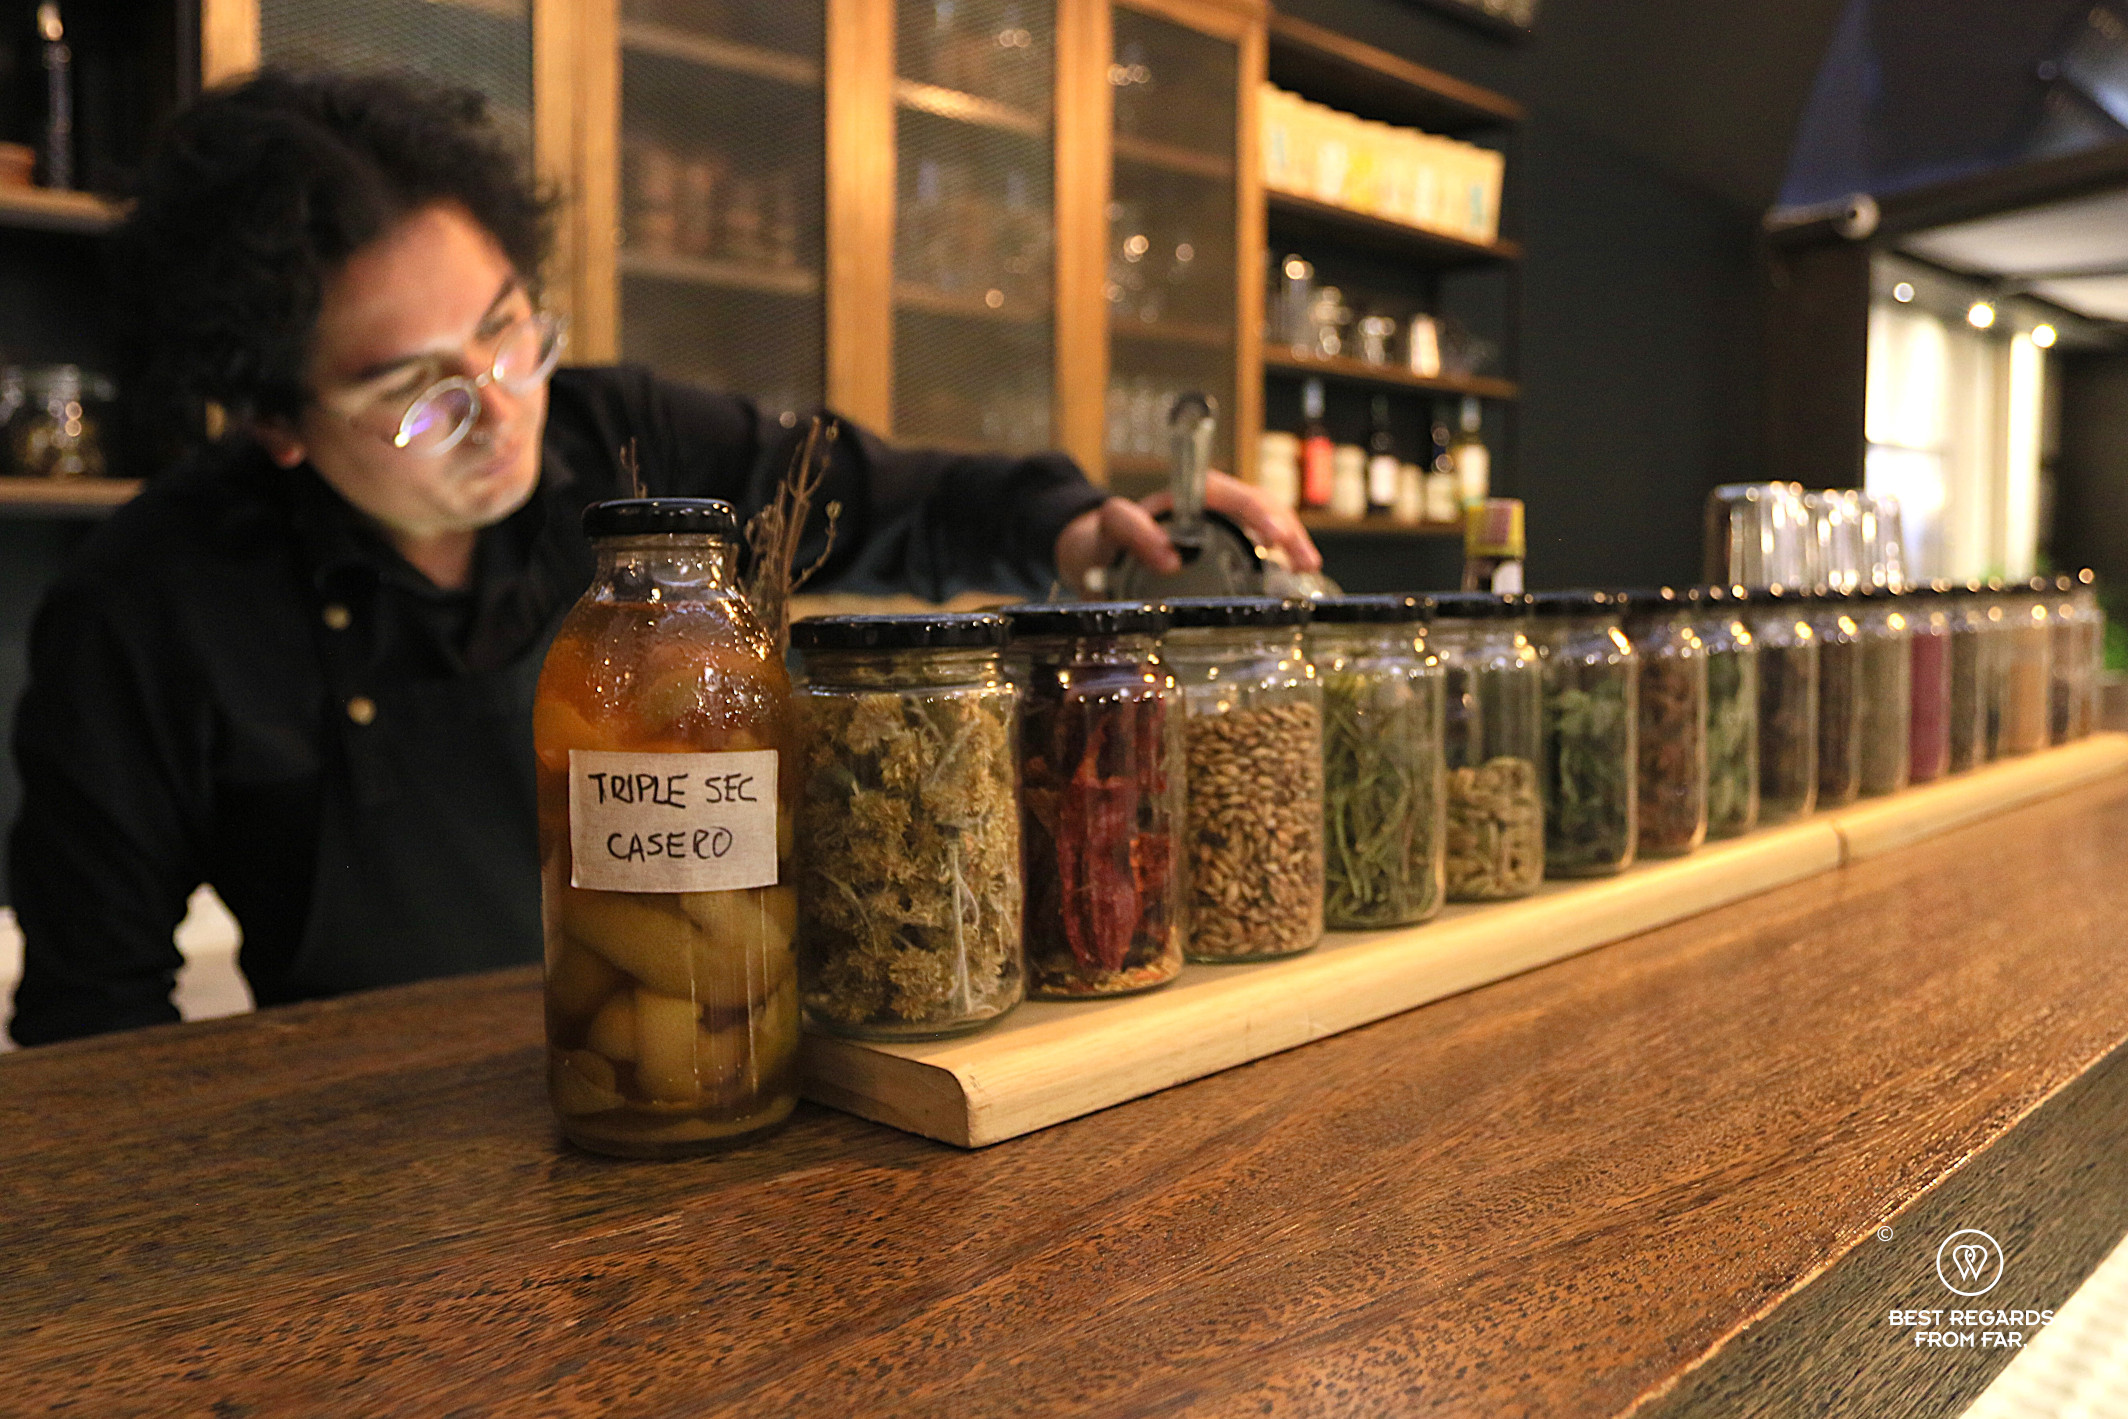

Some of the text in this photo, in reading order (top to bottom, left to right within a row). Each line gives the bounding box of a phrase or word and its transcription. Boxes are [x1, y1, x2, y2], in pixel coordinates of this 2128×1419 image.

[588, 772, 758, 809] TRIPLE SEC
[607, 826, 733, 863] CASERO
